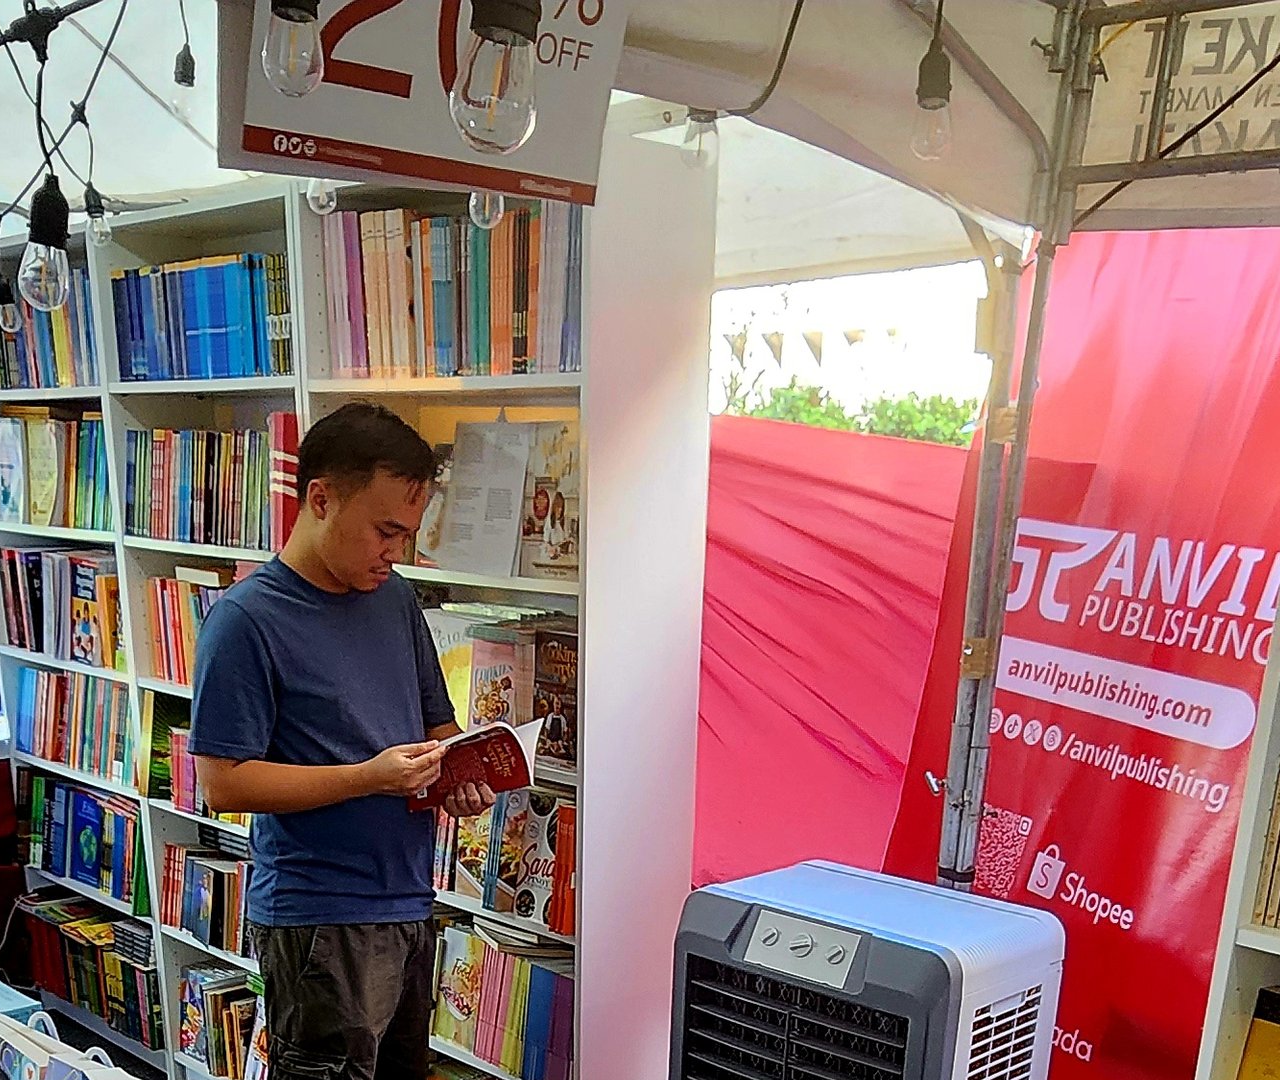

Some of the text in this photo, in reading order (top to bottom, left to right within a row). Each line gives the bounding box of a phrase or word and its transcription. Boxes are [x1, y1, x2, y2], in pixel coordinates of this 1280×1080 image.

[536, 32, 593, 71] OFF
[1008, 658, 1213, 728] anvilpublishing.com
[1060, 734, 1230, 813] /anvilpublishing
[1060, 871, 1134, 930] Shopee
